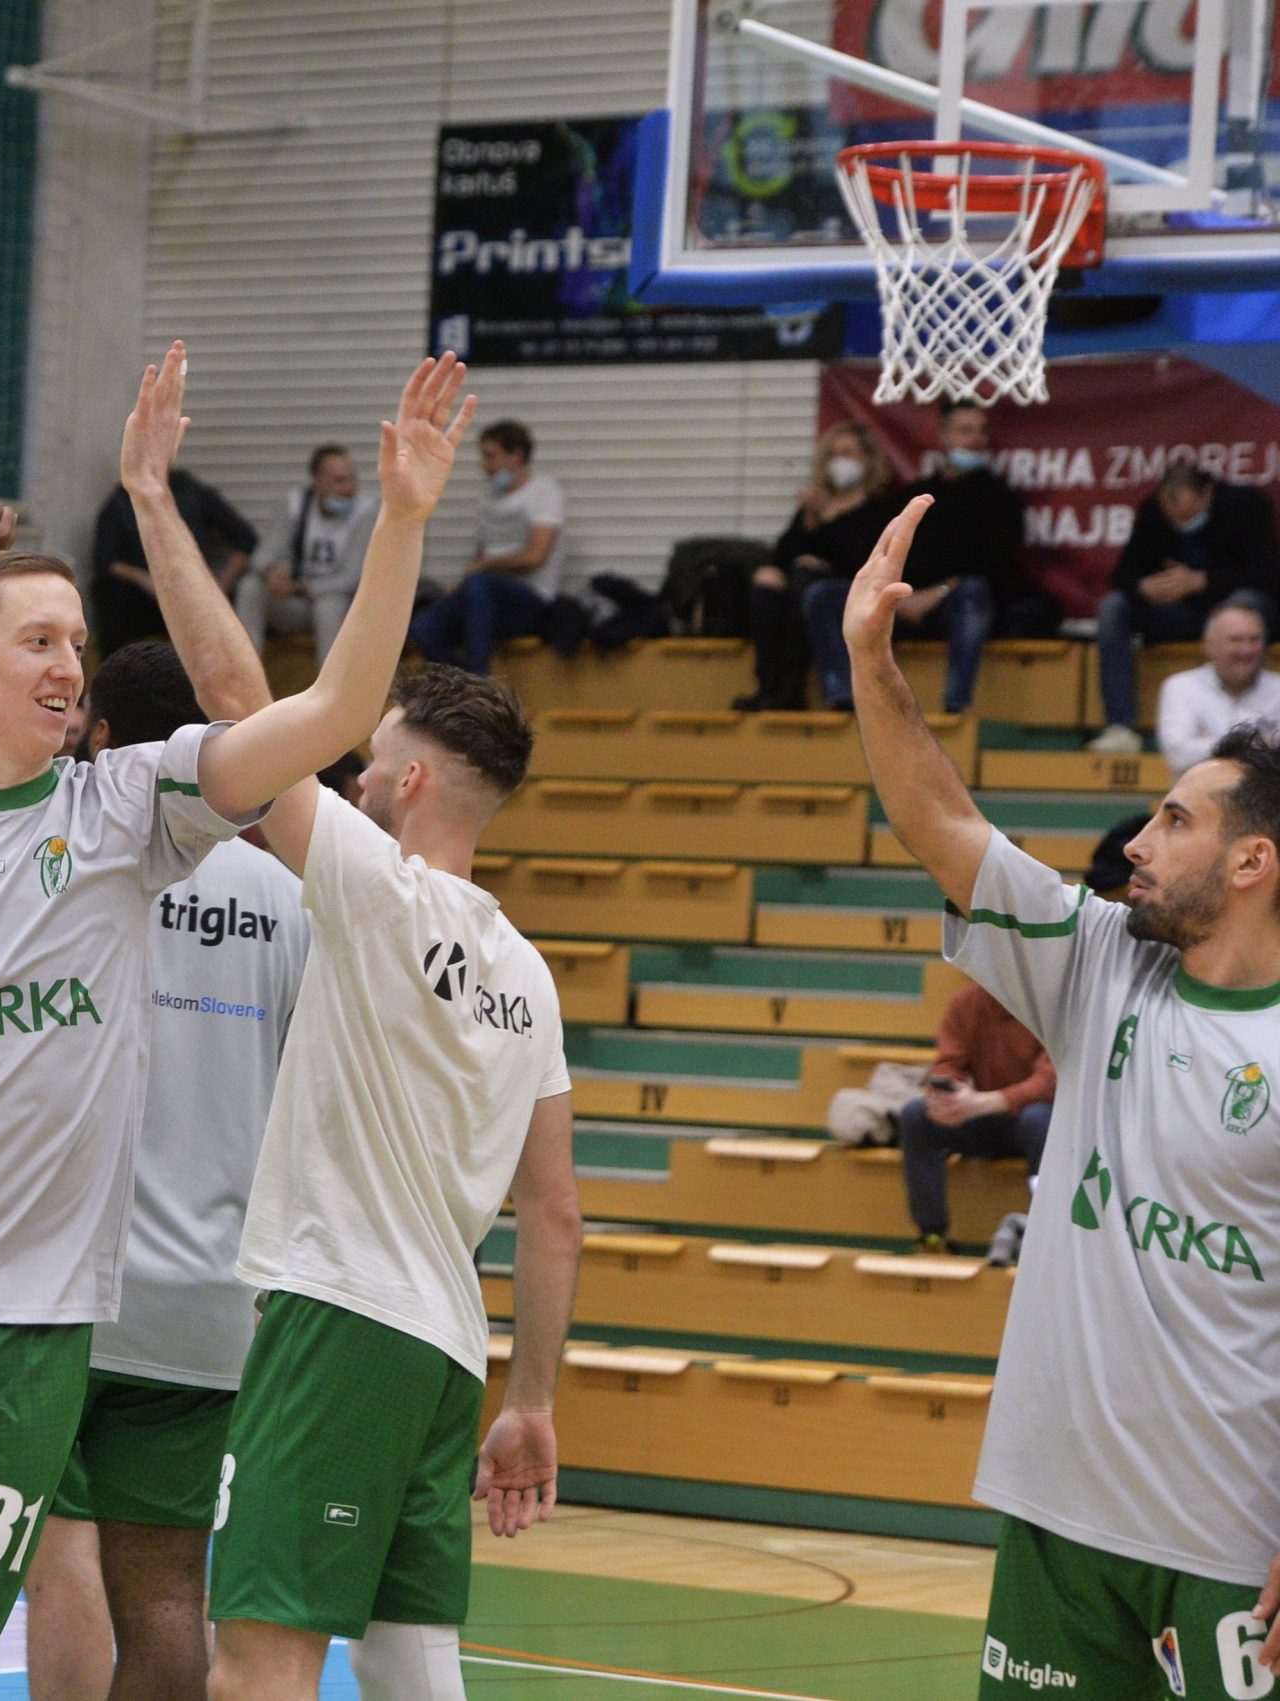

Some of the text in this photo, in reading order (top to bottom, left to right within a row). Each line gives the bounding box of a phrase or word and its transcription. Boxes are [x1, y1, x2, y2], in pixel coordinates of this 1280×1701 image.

[159, 892, 278, 947] triglav
[1006, 1657, 1078, 1690] triglav
[1215, 1610, 1275, 1701] 6
